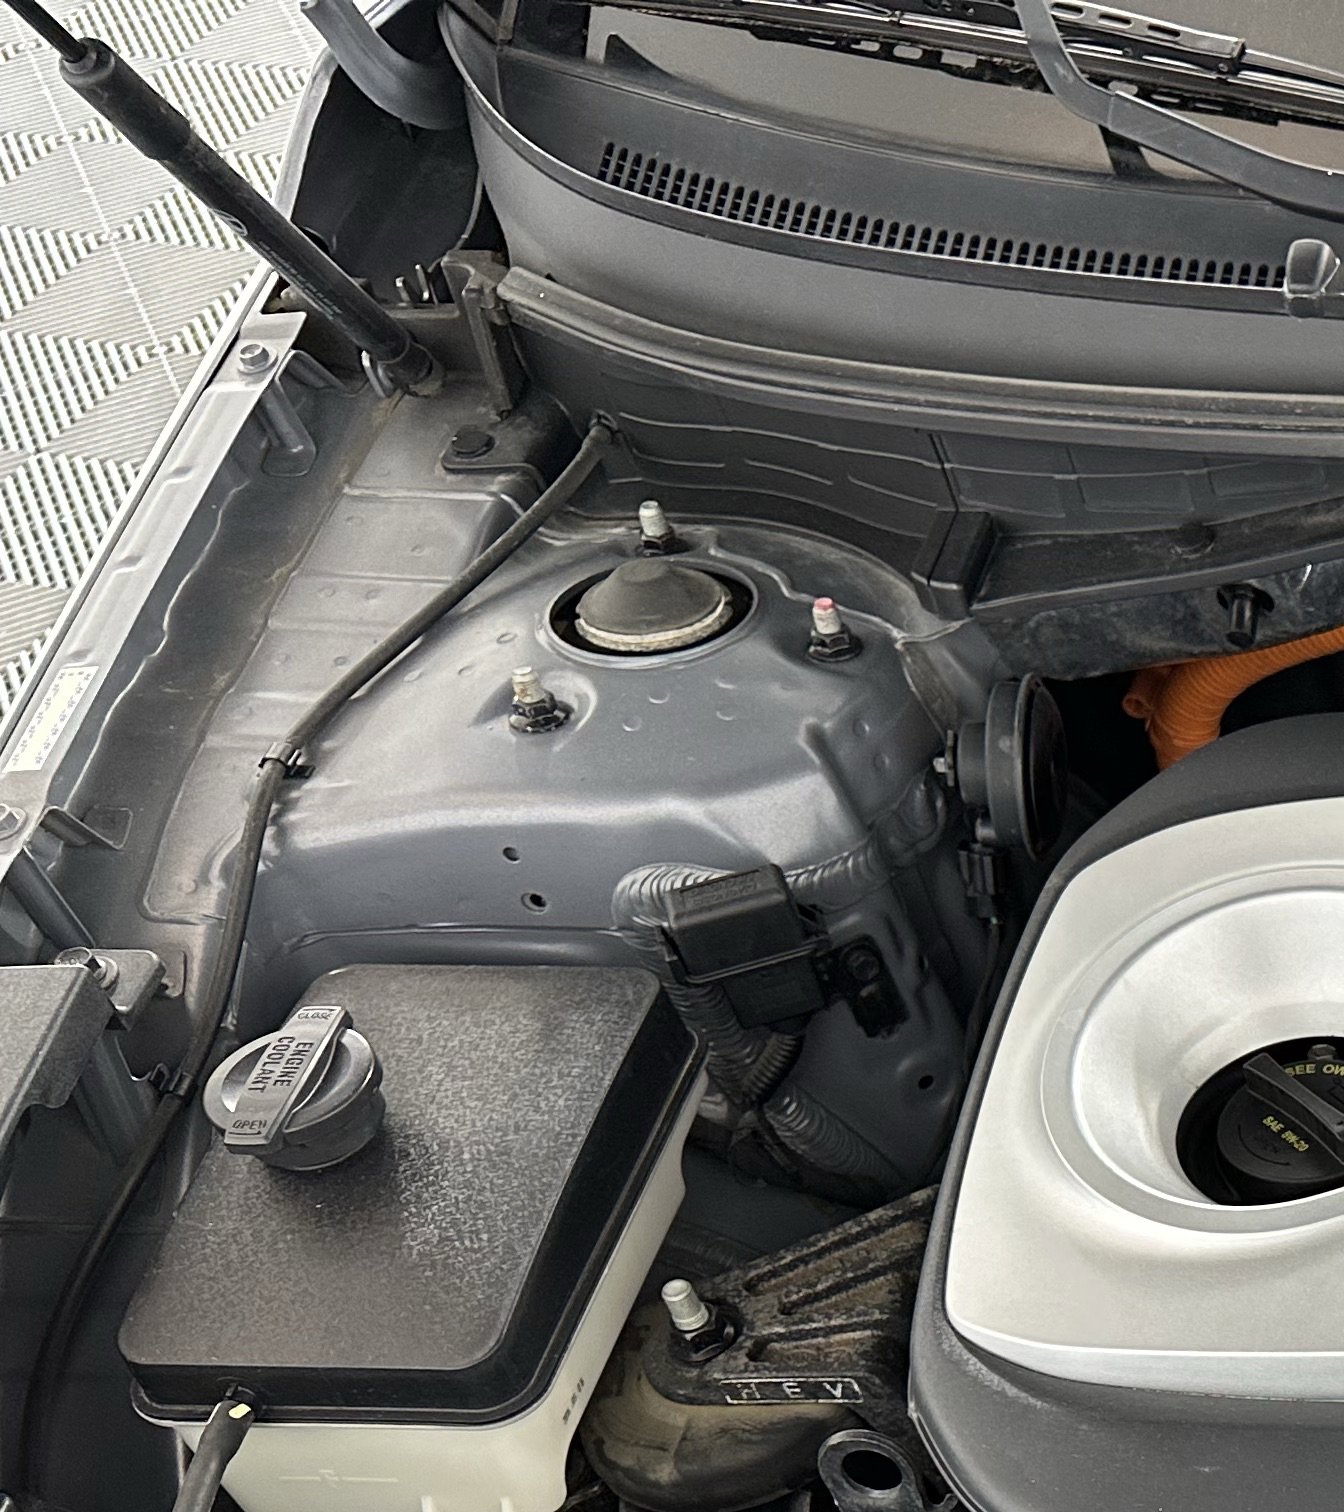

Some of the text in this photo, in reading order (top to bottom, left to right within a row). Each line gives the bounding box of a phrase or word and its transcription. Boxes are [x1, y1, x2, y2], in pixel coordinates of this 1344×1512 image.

[248, 1035, 296, 1093] COOLANT
[272, 1041, 314, 1088] ENGINE
[1285, 1063, 1317, 1078] SEE
[231, 1119, 268, 1130] OPEN
[1262, 1114, 1282, 1135] SAE
